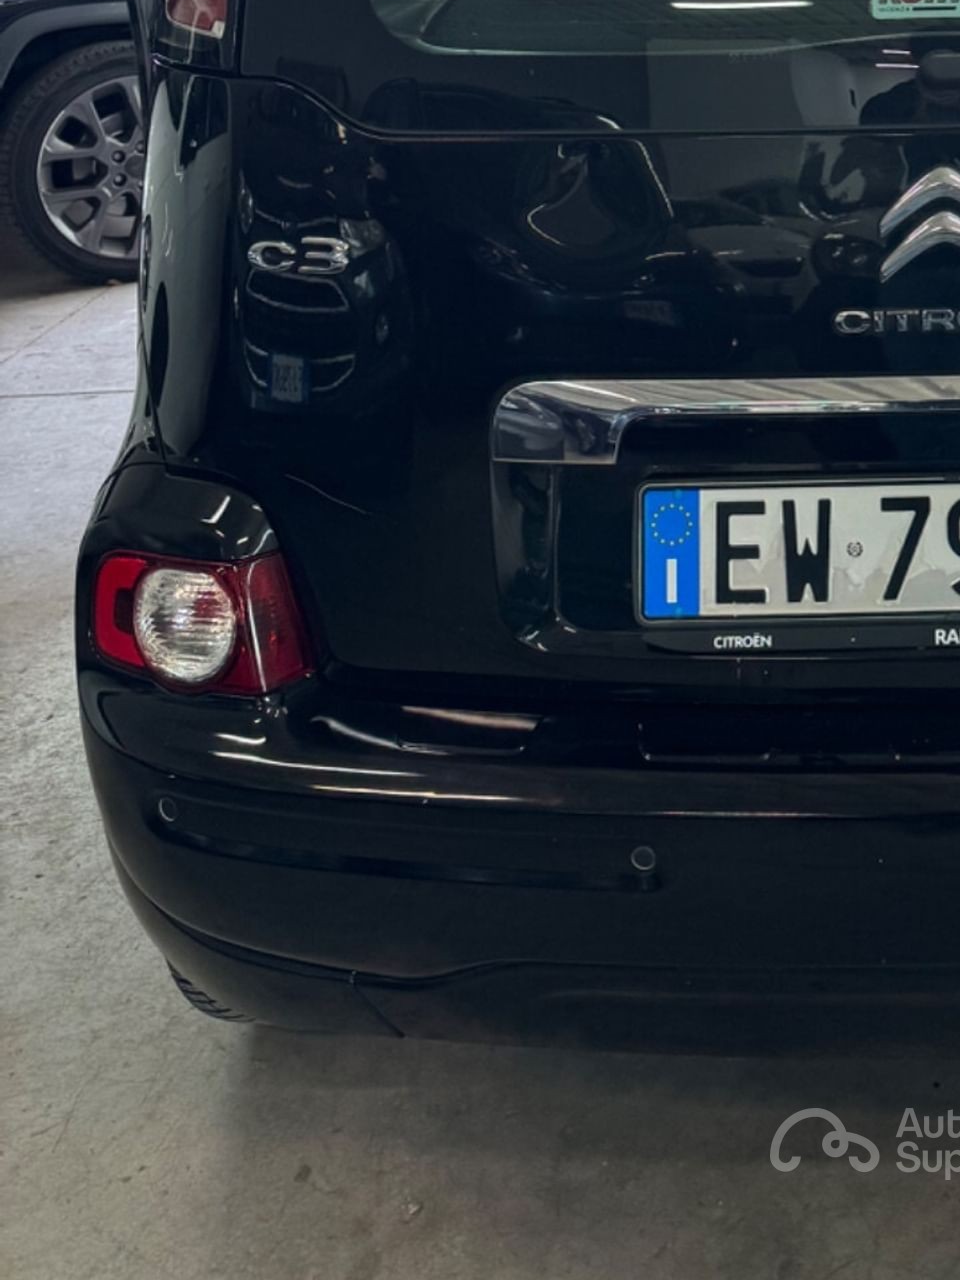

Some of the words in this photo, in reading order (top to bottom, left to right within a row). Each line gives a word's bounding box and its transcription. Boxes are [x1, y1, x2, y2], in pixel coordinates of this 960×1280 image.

[248, 236, 350, 274] C3
[714, 497, 832, 604] EW
[713, 632, 773, 649] CITROËN
